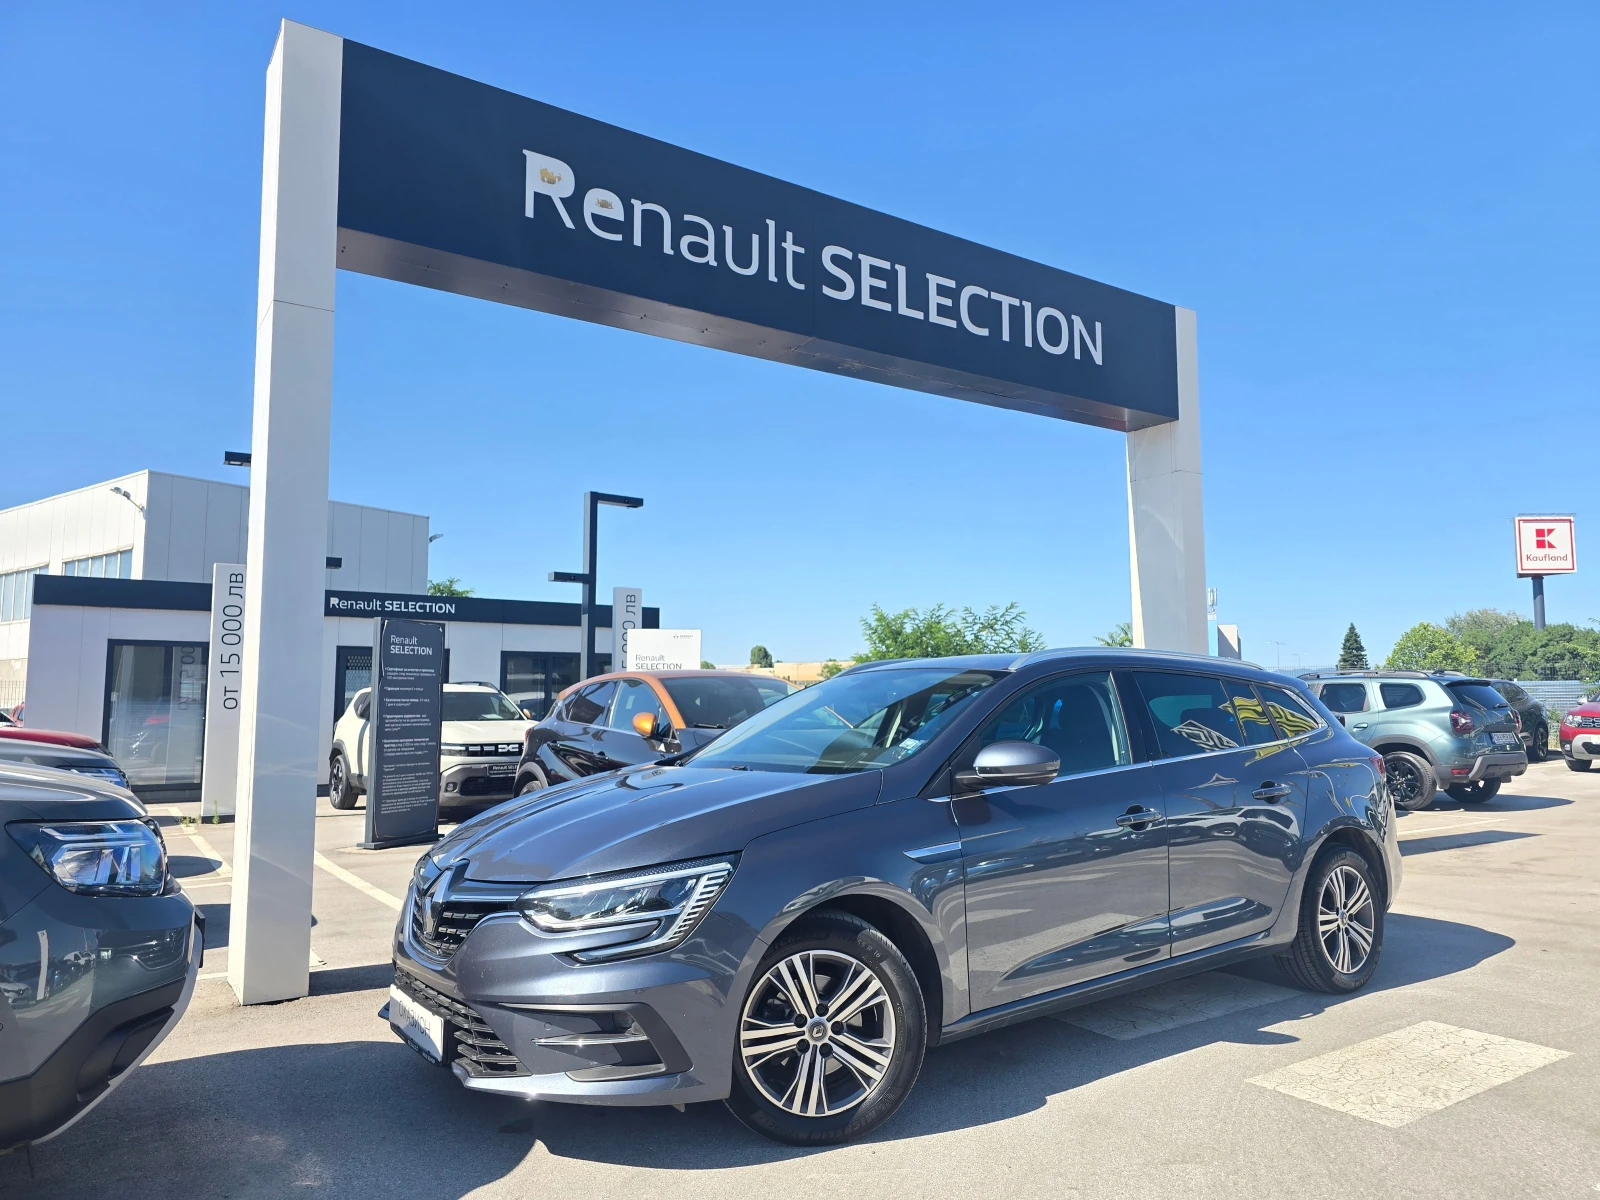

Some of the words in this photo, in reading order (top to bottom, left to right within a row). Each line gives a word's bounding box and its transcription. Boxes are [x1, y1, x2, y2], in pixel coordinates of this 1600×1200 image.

[522, 148, 805, 290] Renault
[821, 245, 1103, 365] SELECTION
[1526, 553, 1568, 562] Kaufland
[329, 597, 382, 611] Renault
[384, 600, 456, 614] SELECTION
[221, 604, 243, 646] 000
[390, 634, 418, 645] Renault
[390, 644, 433, 656] SELECTION
[635, 654, 665, 662] Renault
[219, 653, 240, 678] 15
[635, 662, 682, 671] SELECTION
